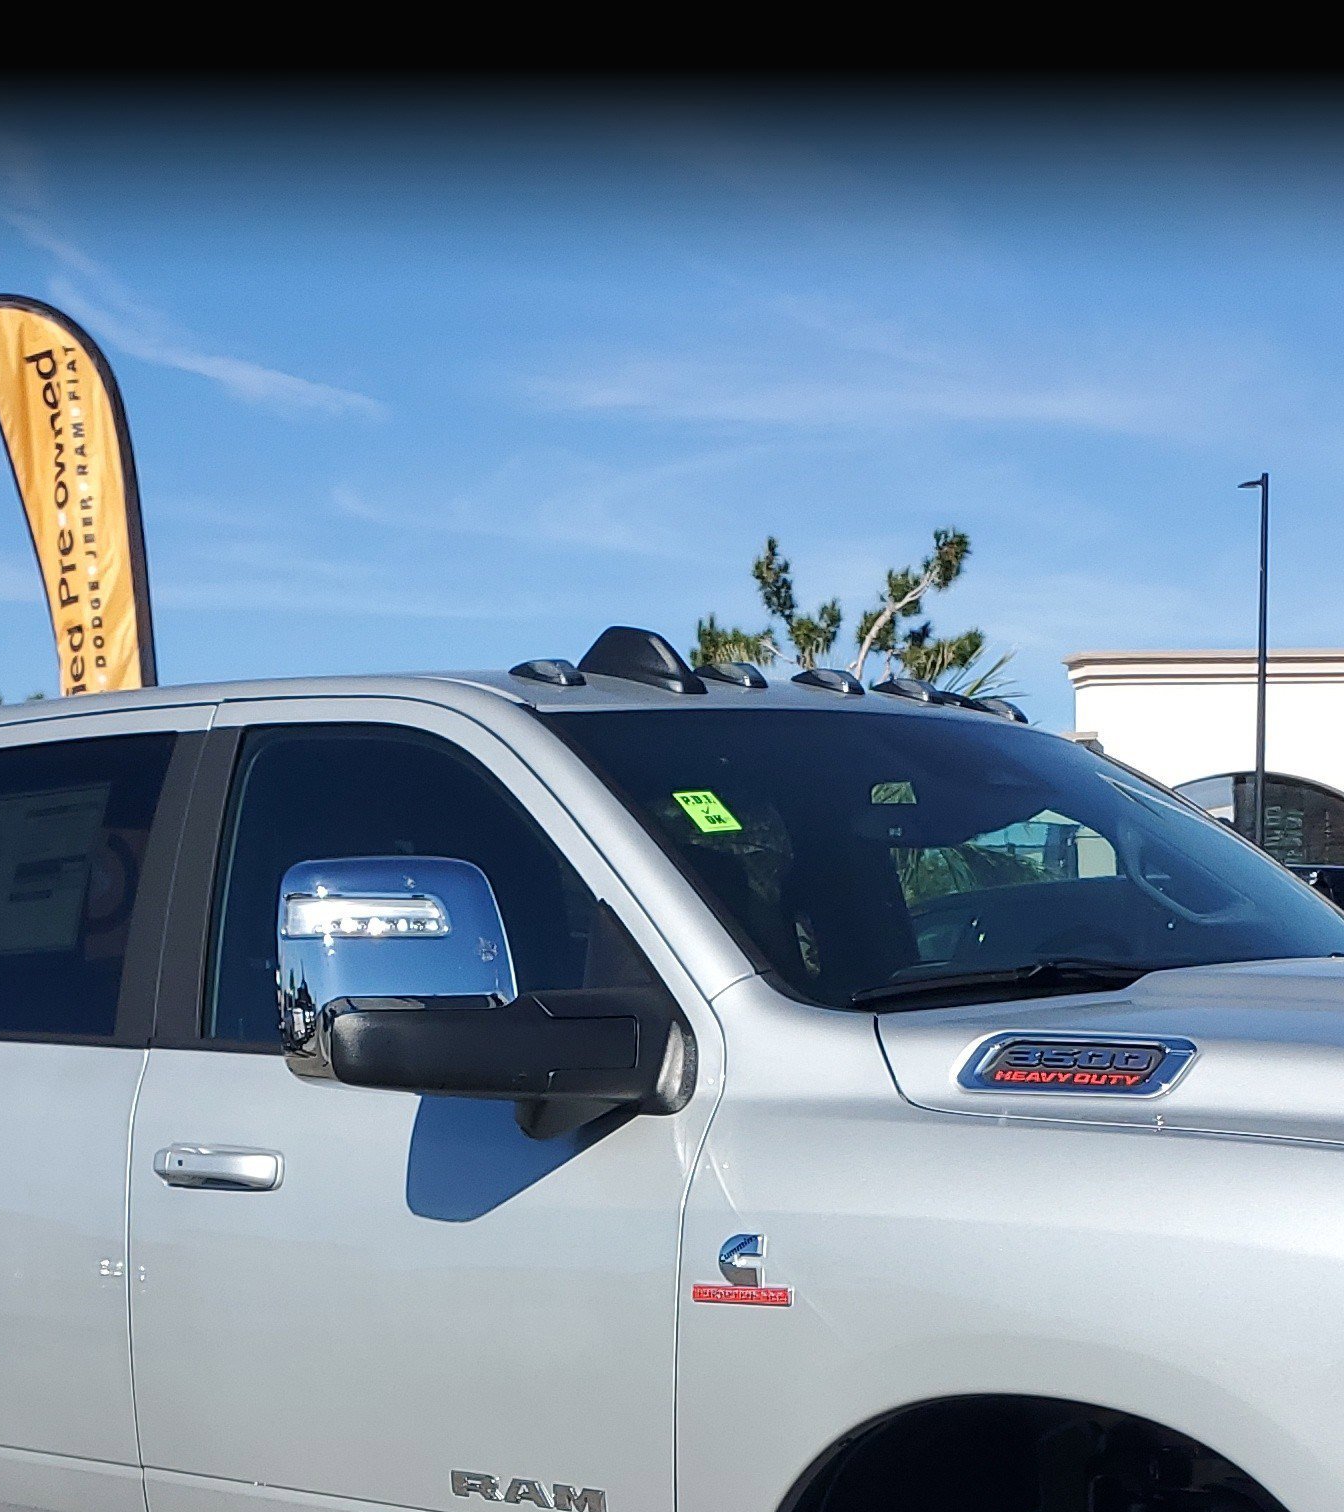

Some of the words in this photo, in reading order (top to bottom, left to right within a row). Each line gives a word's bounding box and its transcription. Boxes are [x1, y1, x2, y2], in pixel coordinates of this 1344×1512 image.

[62, 345, 81, 402] FIAT
[71, 421, 89, 476] RAM
[79, 495, 98, 558] JEEP
[88, 580, 107, 668] DODGE
[704, 814, 727, 826] OK
[994, 1069, 1073, 1083] HEAVY
[1073, 1072, 1142, 1086] DUTY
[1006, 1049, 1154, 1071] 3500
